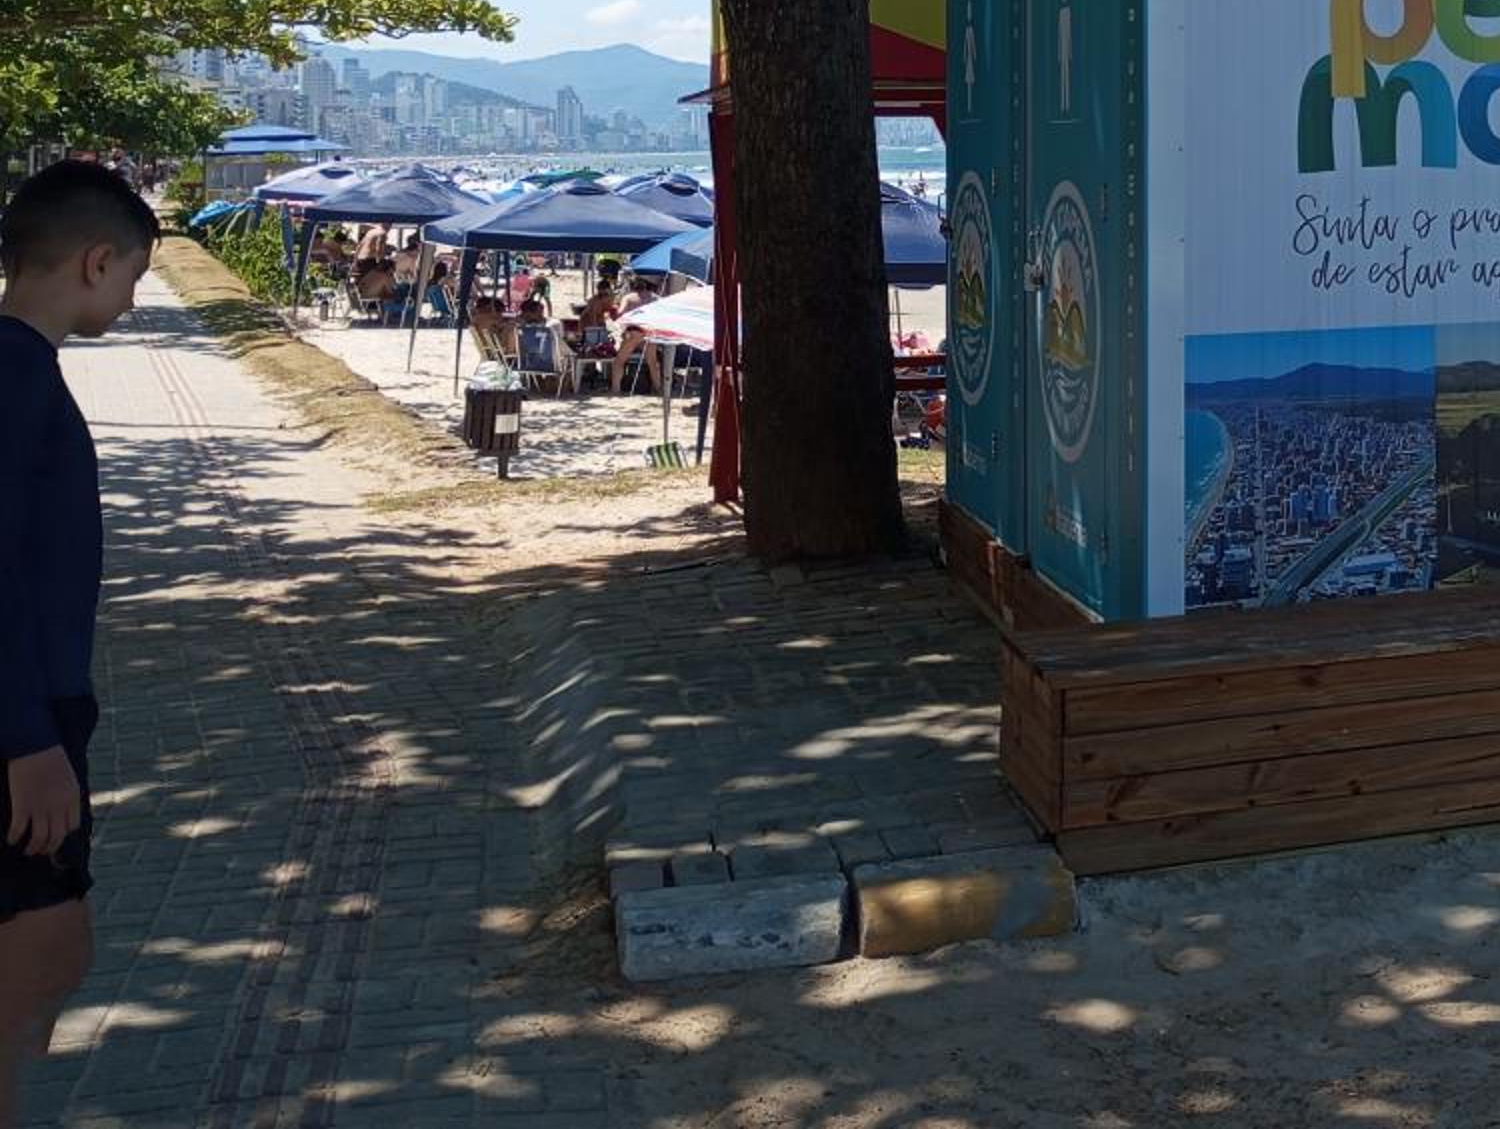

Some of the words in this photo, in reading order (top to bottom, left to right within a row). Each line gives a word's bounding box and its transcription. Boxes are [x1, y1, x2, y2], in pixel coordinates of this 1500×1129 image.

[1293, 193, 1399, 256] Sinta
[1413, 208, 1438, 240] o
[1311, 249, 1358, 291] de
[1367, 243, 1461, 299] estar
